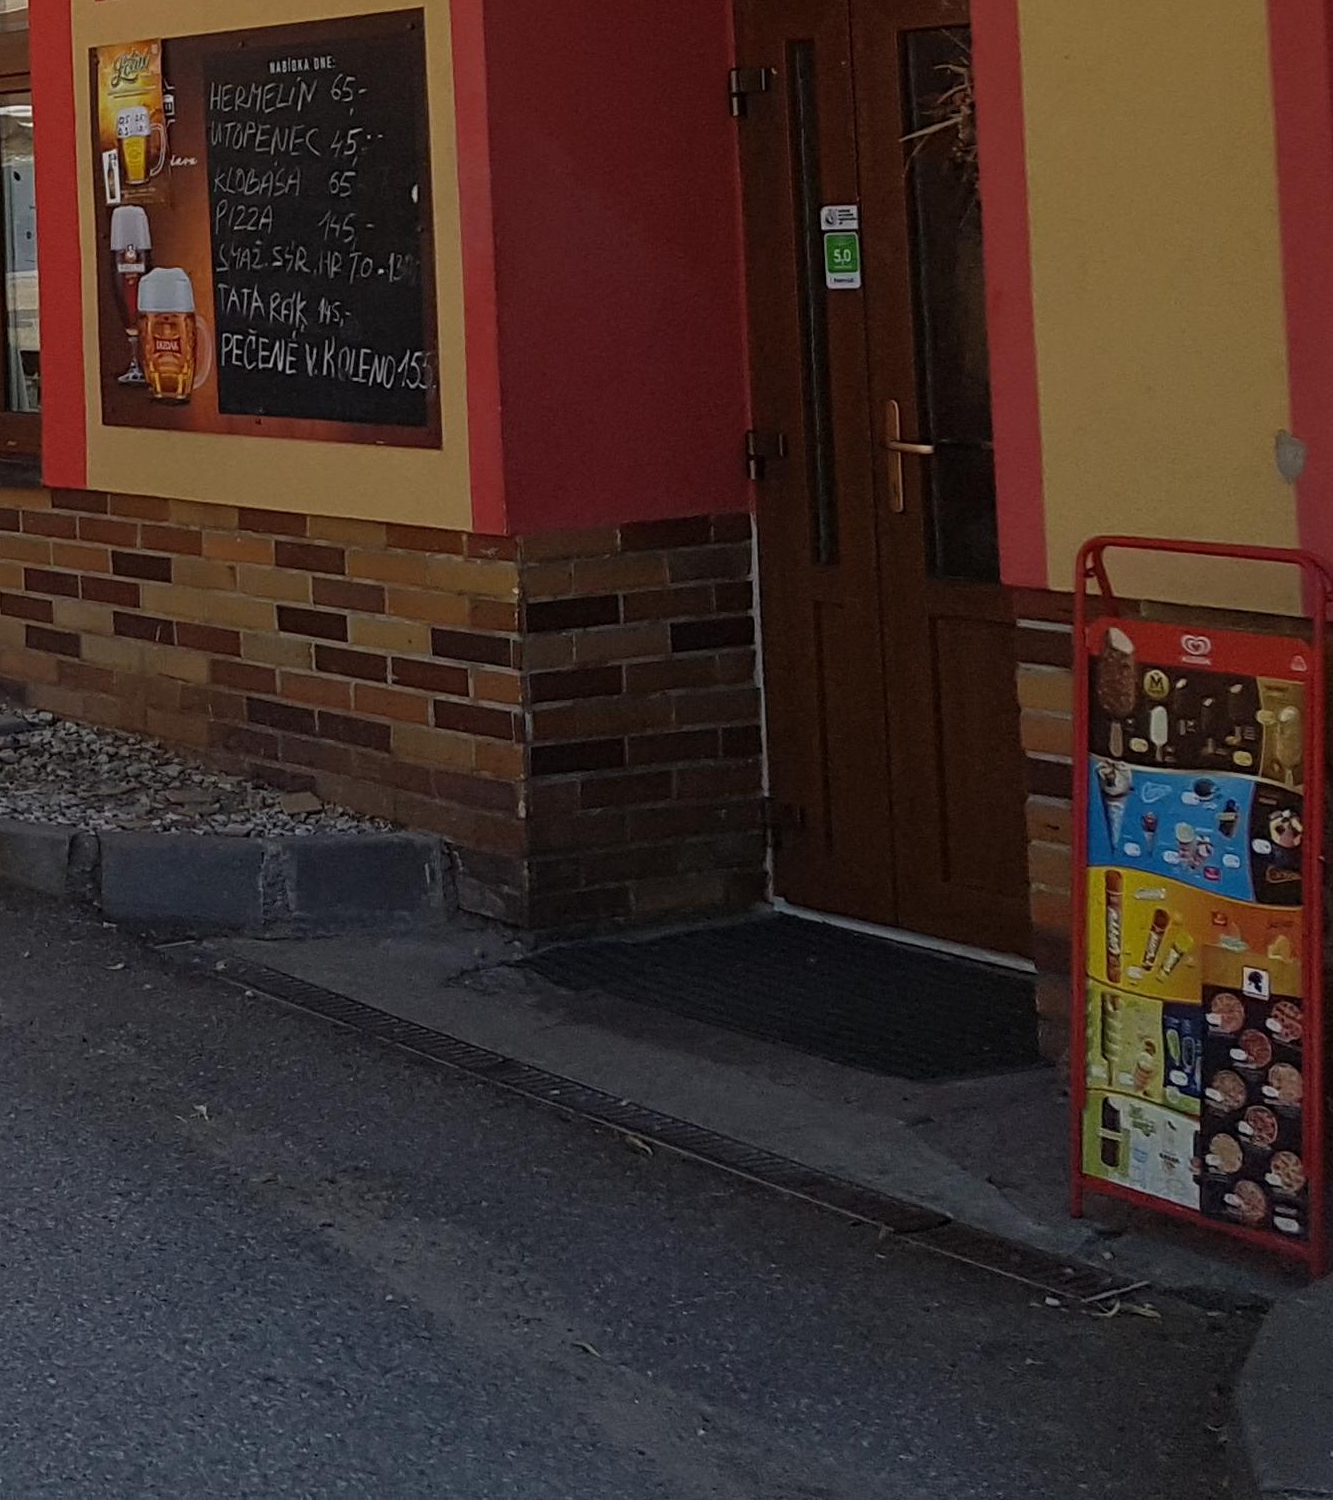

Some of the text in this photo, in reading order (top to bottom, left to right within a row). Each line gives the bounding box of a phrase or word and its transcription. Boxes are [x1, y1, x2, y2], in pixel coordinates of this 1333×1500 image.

[269, 55, 336, 74] NABÍDKA DNE:
[209, 76, 318, 113] HERMELÍN
[210, 121, 322, 156] UTOPENEC
[213, 161, 301, 197] KLOBÁSA
[215, 199, 274, 235] PIZZA
[221, 328, 300, 375] PEČENÉ
[322, 334, 397, 390] KOLENO
